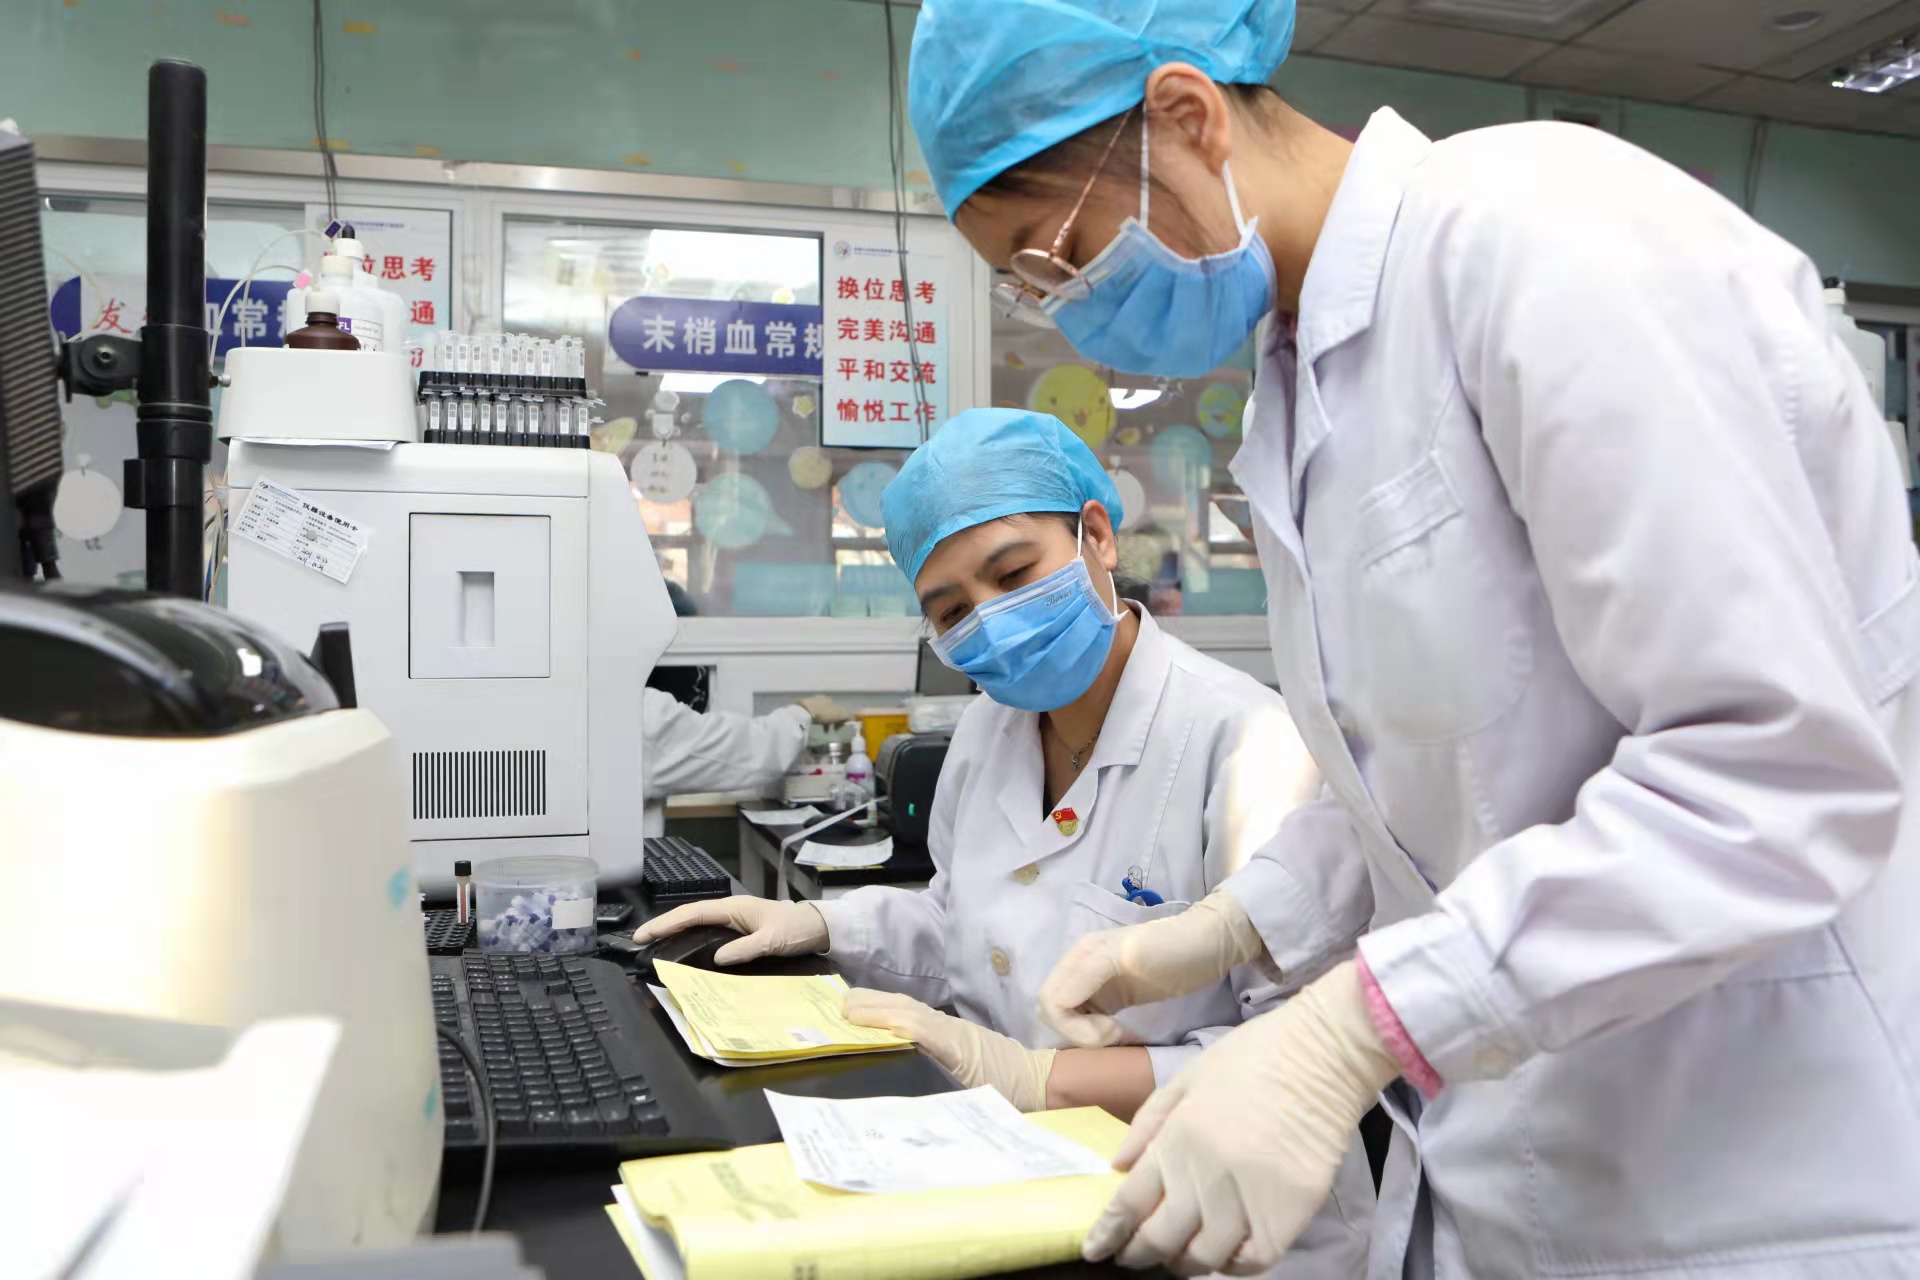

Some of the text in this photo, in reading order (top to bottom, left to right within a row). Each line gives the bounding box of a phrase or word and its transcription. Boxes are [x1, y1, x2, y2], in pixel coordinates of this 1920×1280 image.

[837, 276, 937, 304] 换位思考
[837, 317, 937, 344] 完美沟通
[837, 358, 937, 385] 平和交流
[837, 399, 937, 424] 愉悦工作
[303, 502, 358, 532] 仪器设备使用卡
